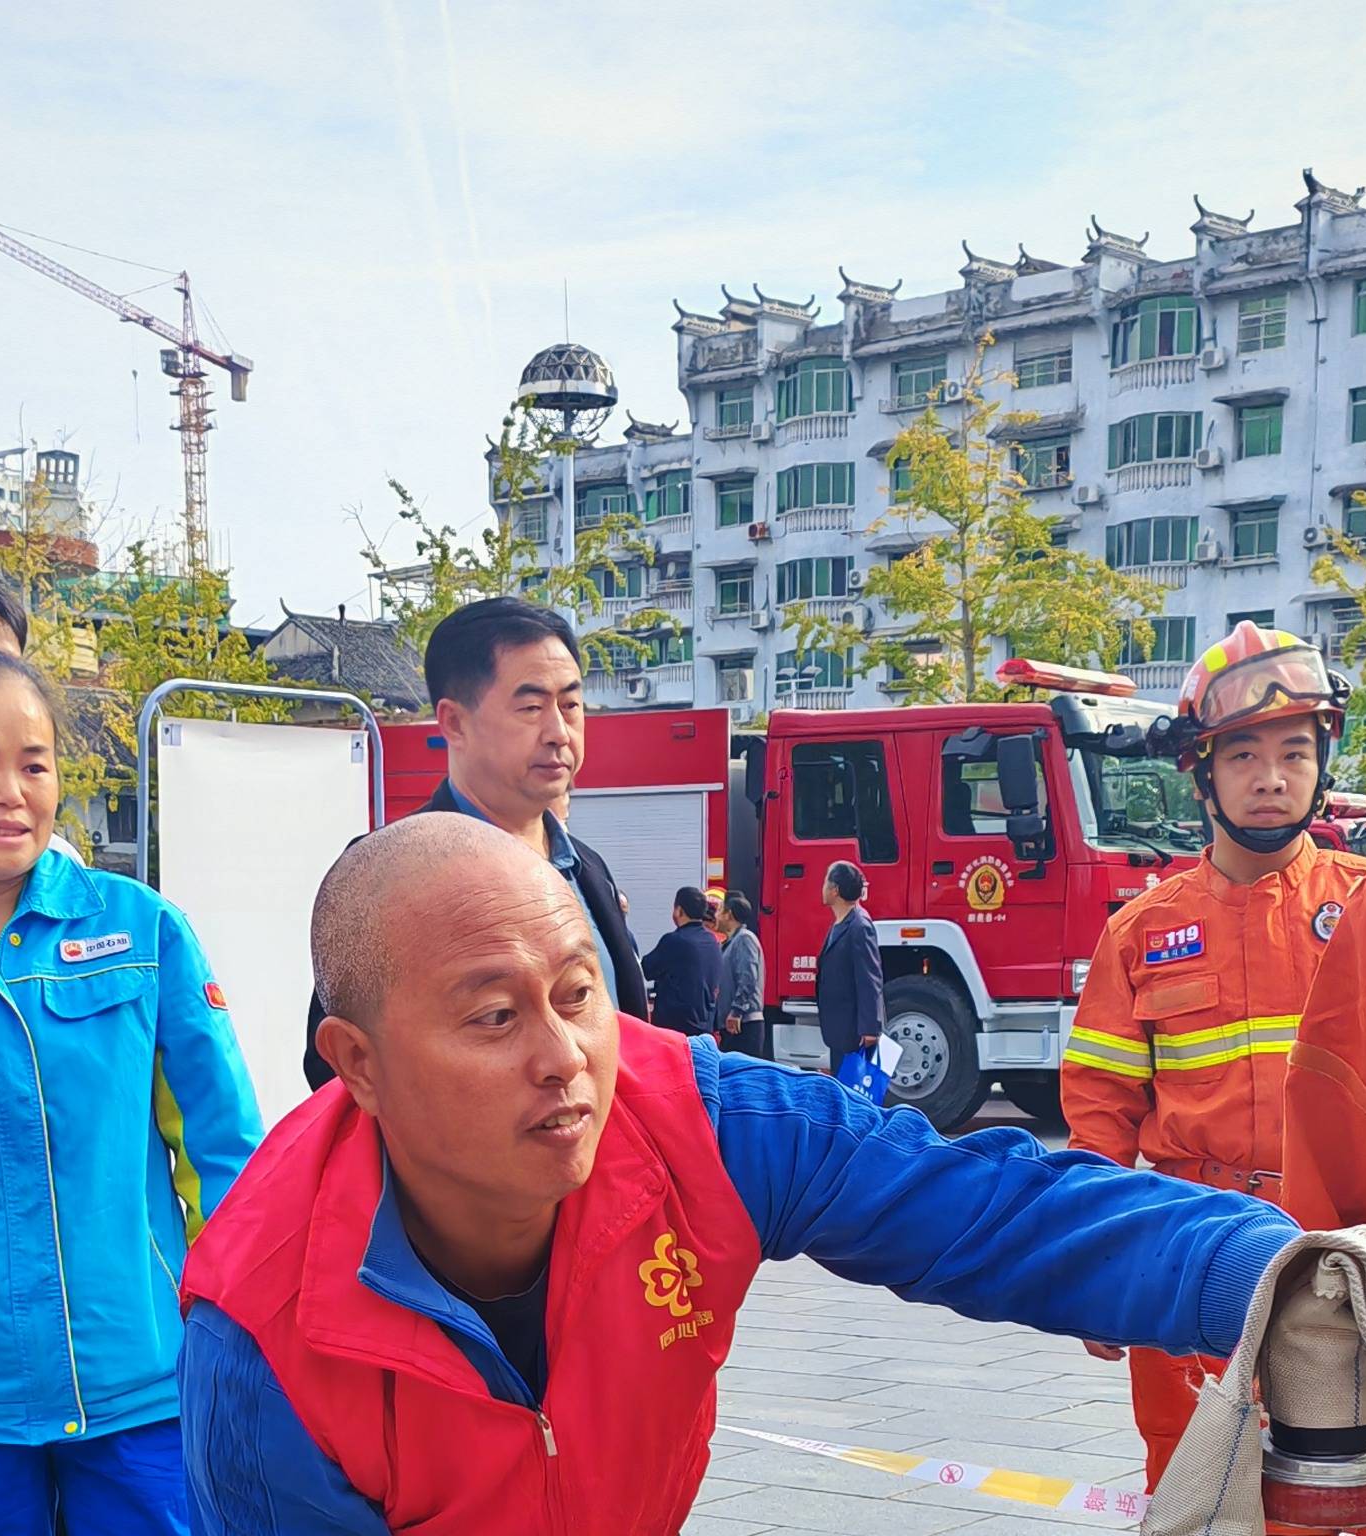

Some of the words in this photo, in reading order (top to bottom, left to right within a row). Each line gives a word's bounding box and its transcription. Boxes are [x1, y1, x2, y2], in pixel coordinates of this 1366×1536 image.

[1165, 925, 1199, 946] 119
[85, 938, 128, 953] 中国石油
